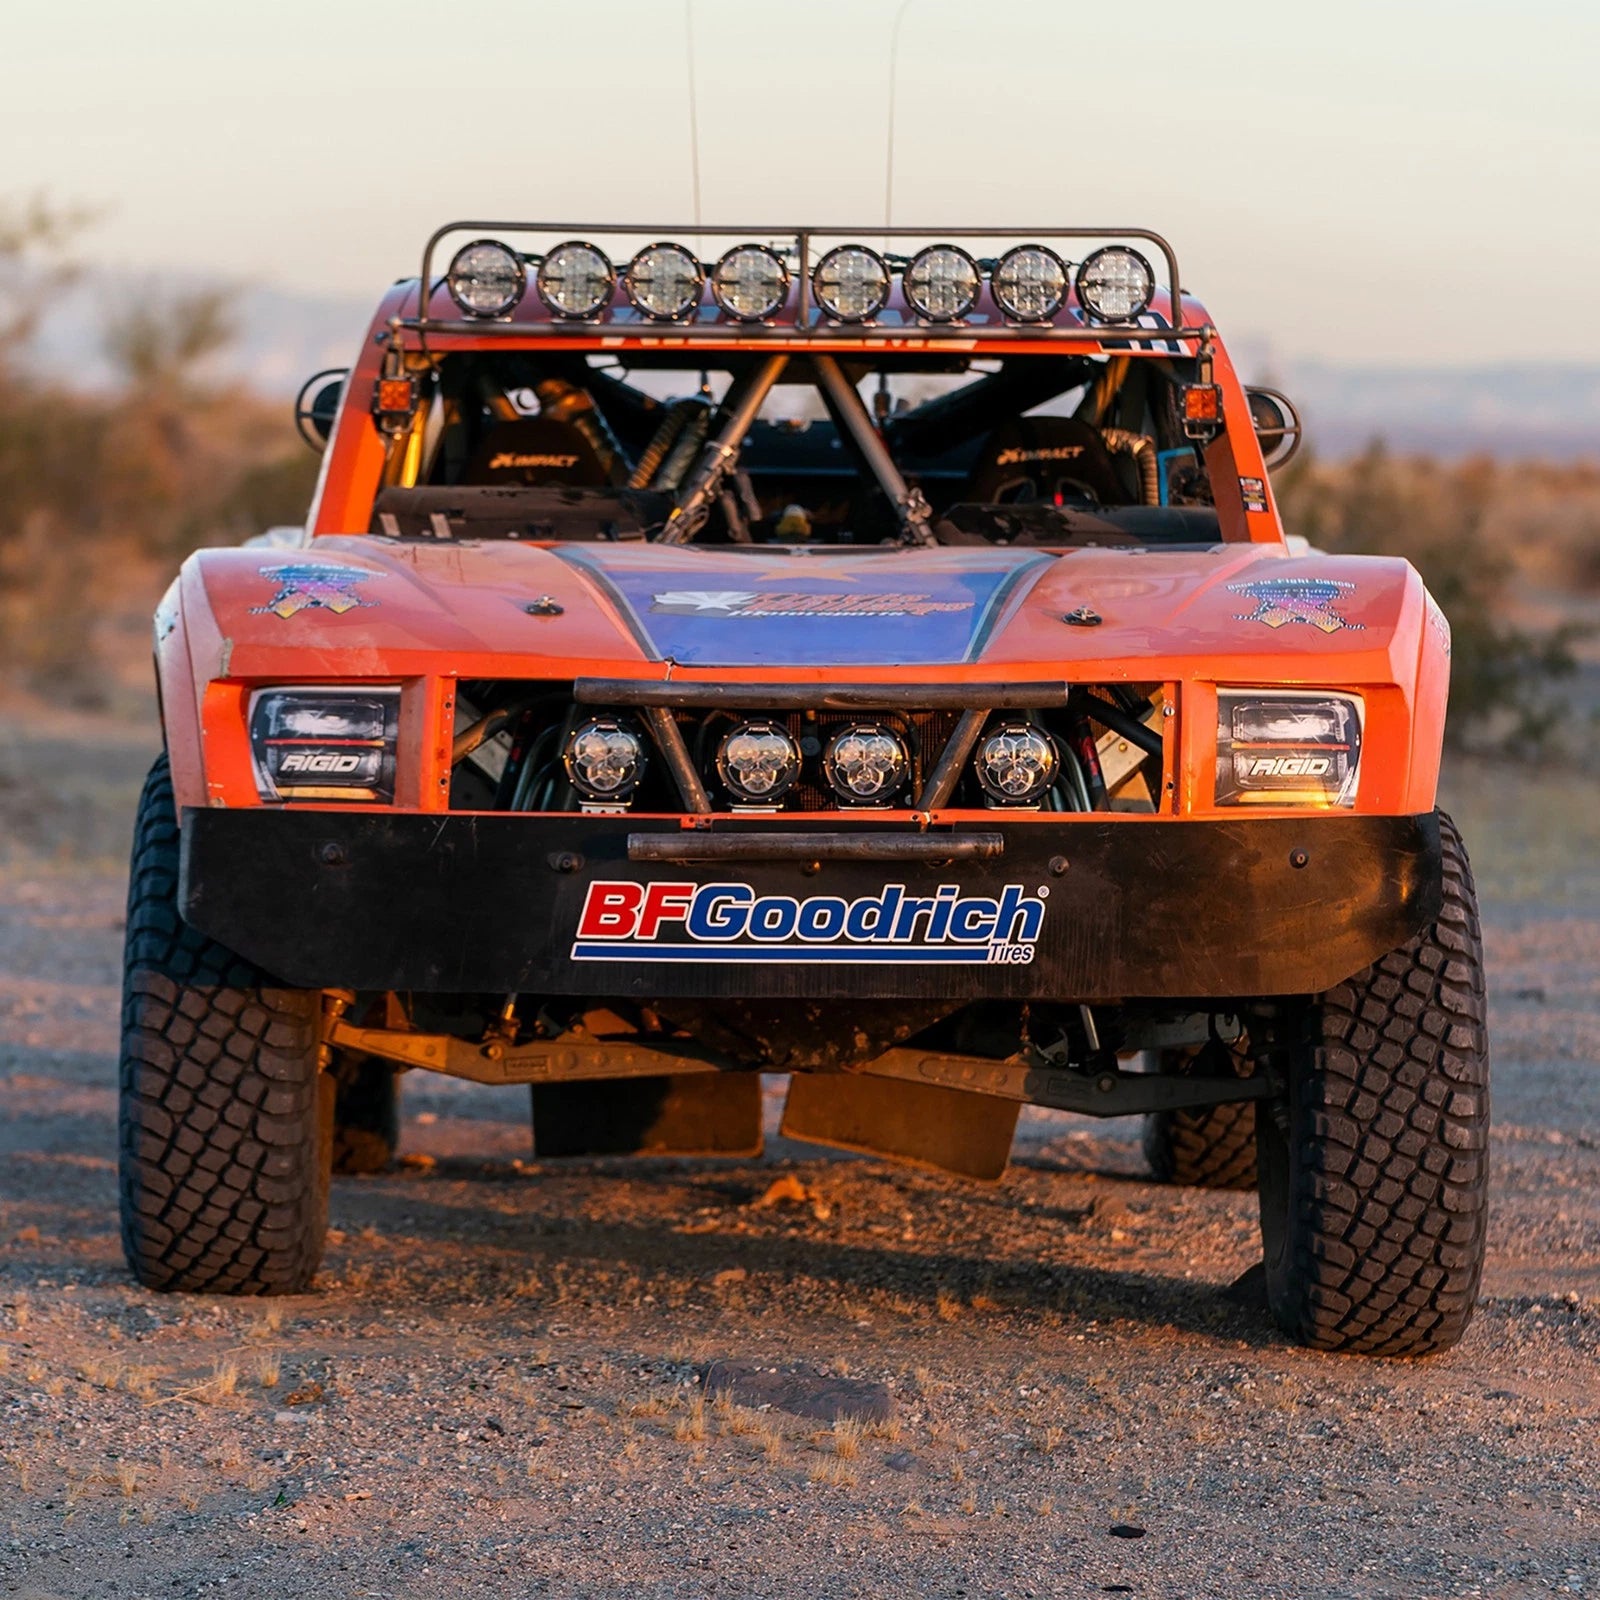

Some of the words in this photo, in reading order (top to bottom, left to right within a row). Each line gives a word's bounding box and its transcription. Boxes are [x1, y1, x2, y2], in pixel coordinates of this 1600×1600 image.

[280, 754, 360, 772] RIGID
[1250, 758, 1330, 776] RIGID
[989, 942, 1034, 964] Tires
